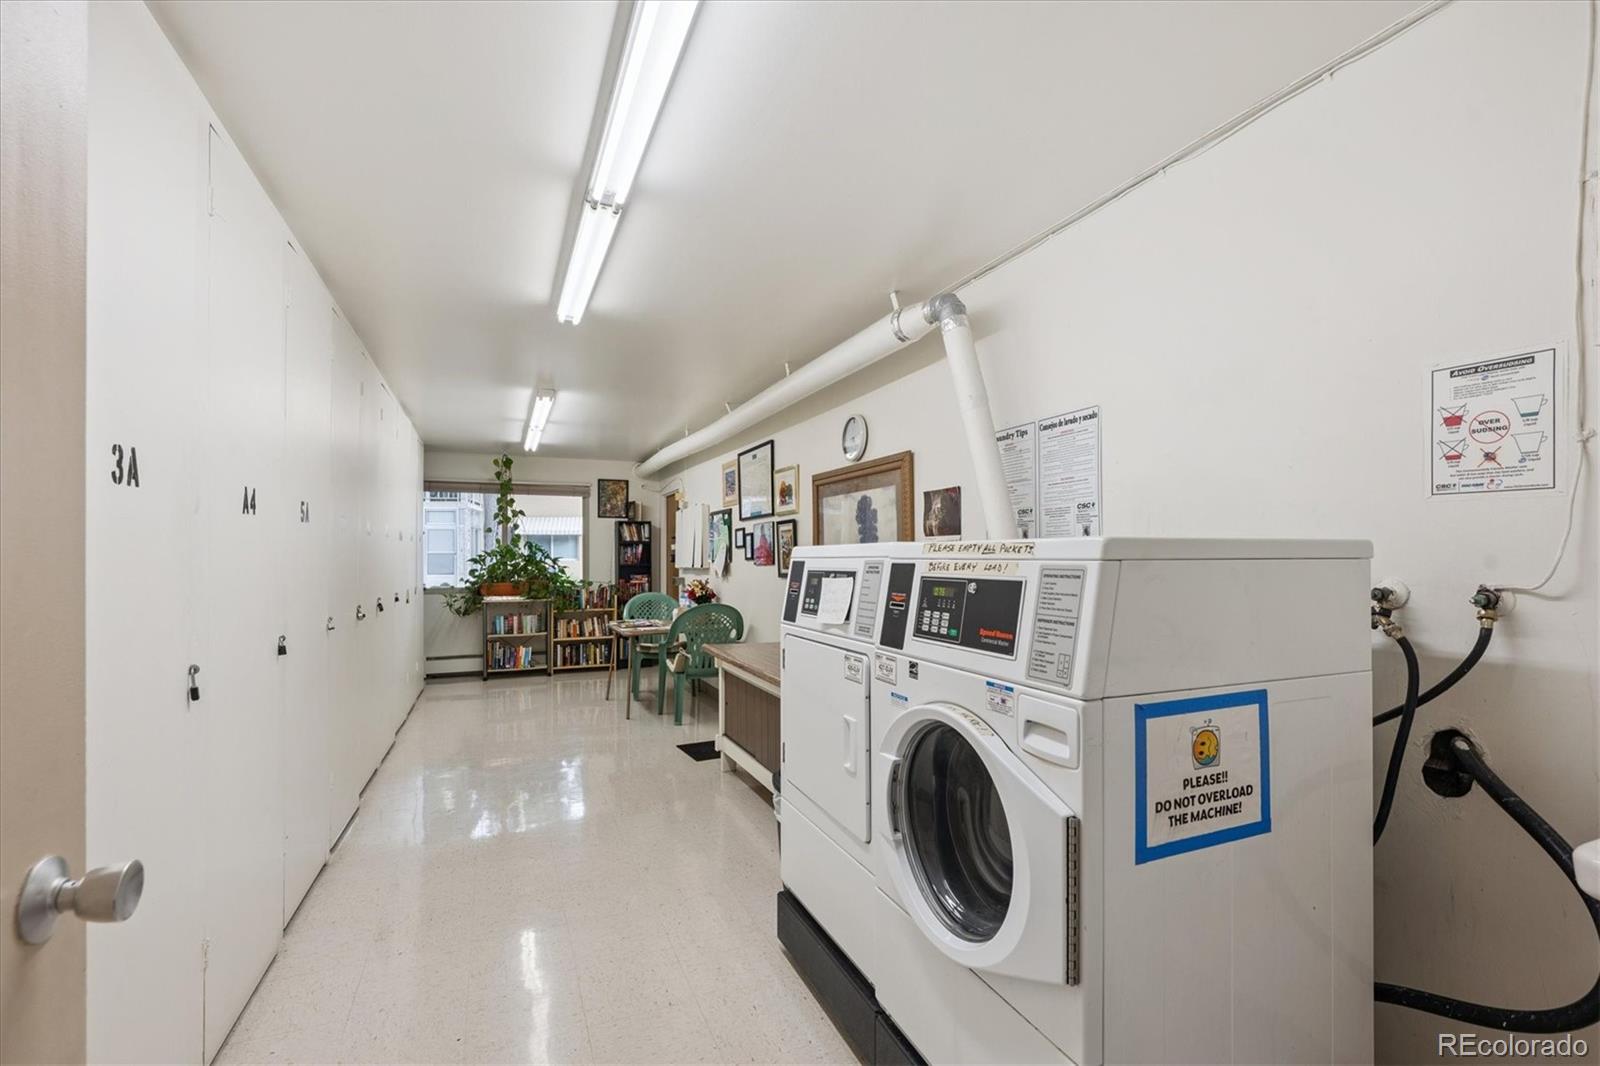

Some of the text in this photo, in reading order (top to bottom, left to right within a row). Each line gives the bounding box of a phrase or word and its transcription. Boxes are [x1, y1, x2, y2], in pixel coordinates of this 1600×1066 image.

[1471, 425, 1508, 434] SUDSING
[1478, 418, 1501, 426] OVER
[1015, 429, 1028, 439] Tips
[111, 444, 140, 488] 3A
[242, 486, 257, 515] A4
[1077, 502, 1091, 510] CSC
[300, 501, 310, 523] 5A
[928, 543, 955, 553] PLEASE
[982, 543, 997, 554] ALL
[953, 562, 978, 573] EVERY
[1183, 770, 1228, 790] PLEASE!!
[1155, 784, 1254, 814] DO NOT OVERLOAD
[1168, 801, 1242, 828] THE MACHINE!
